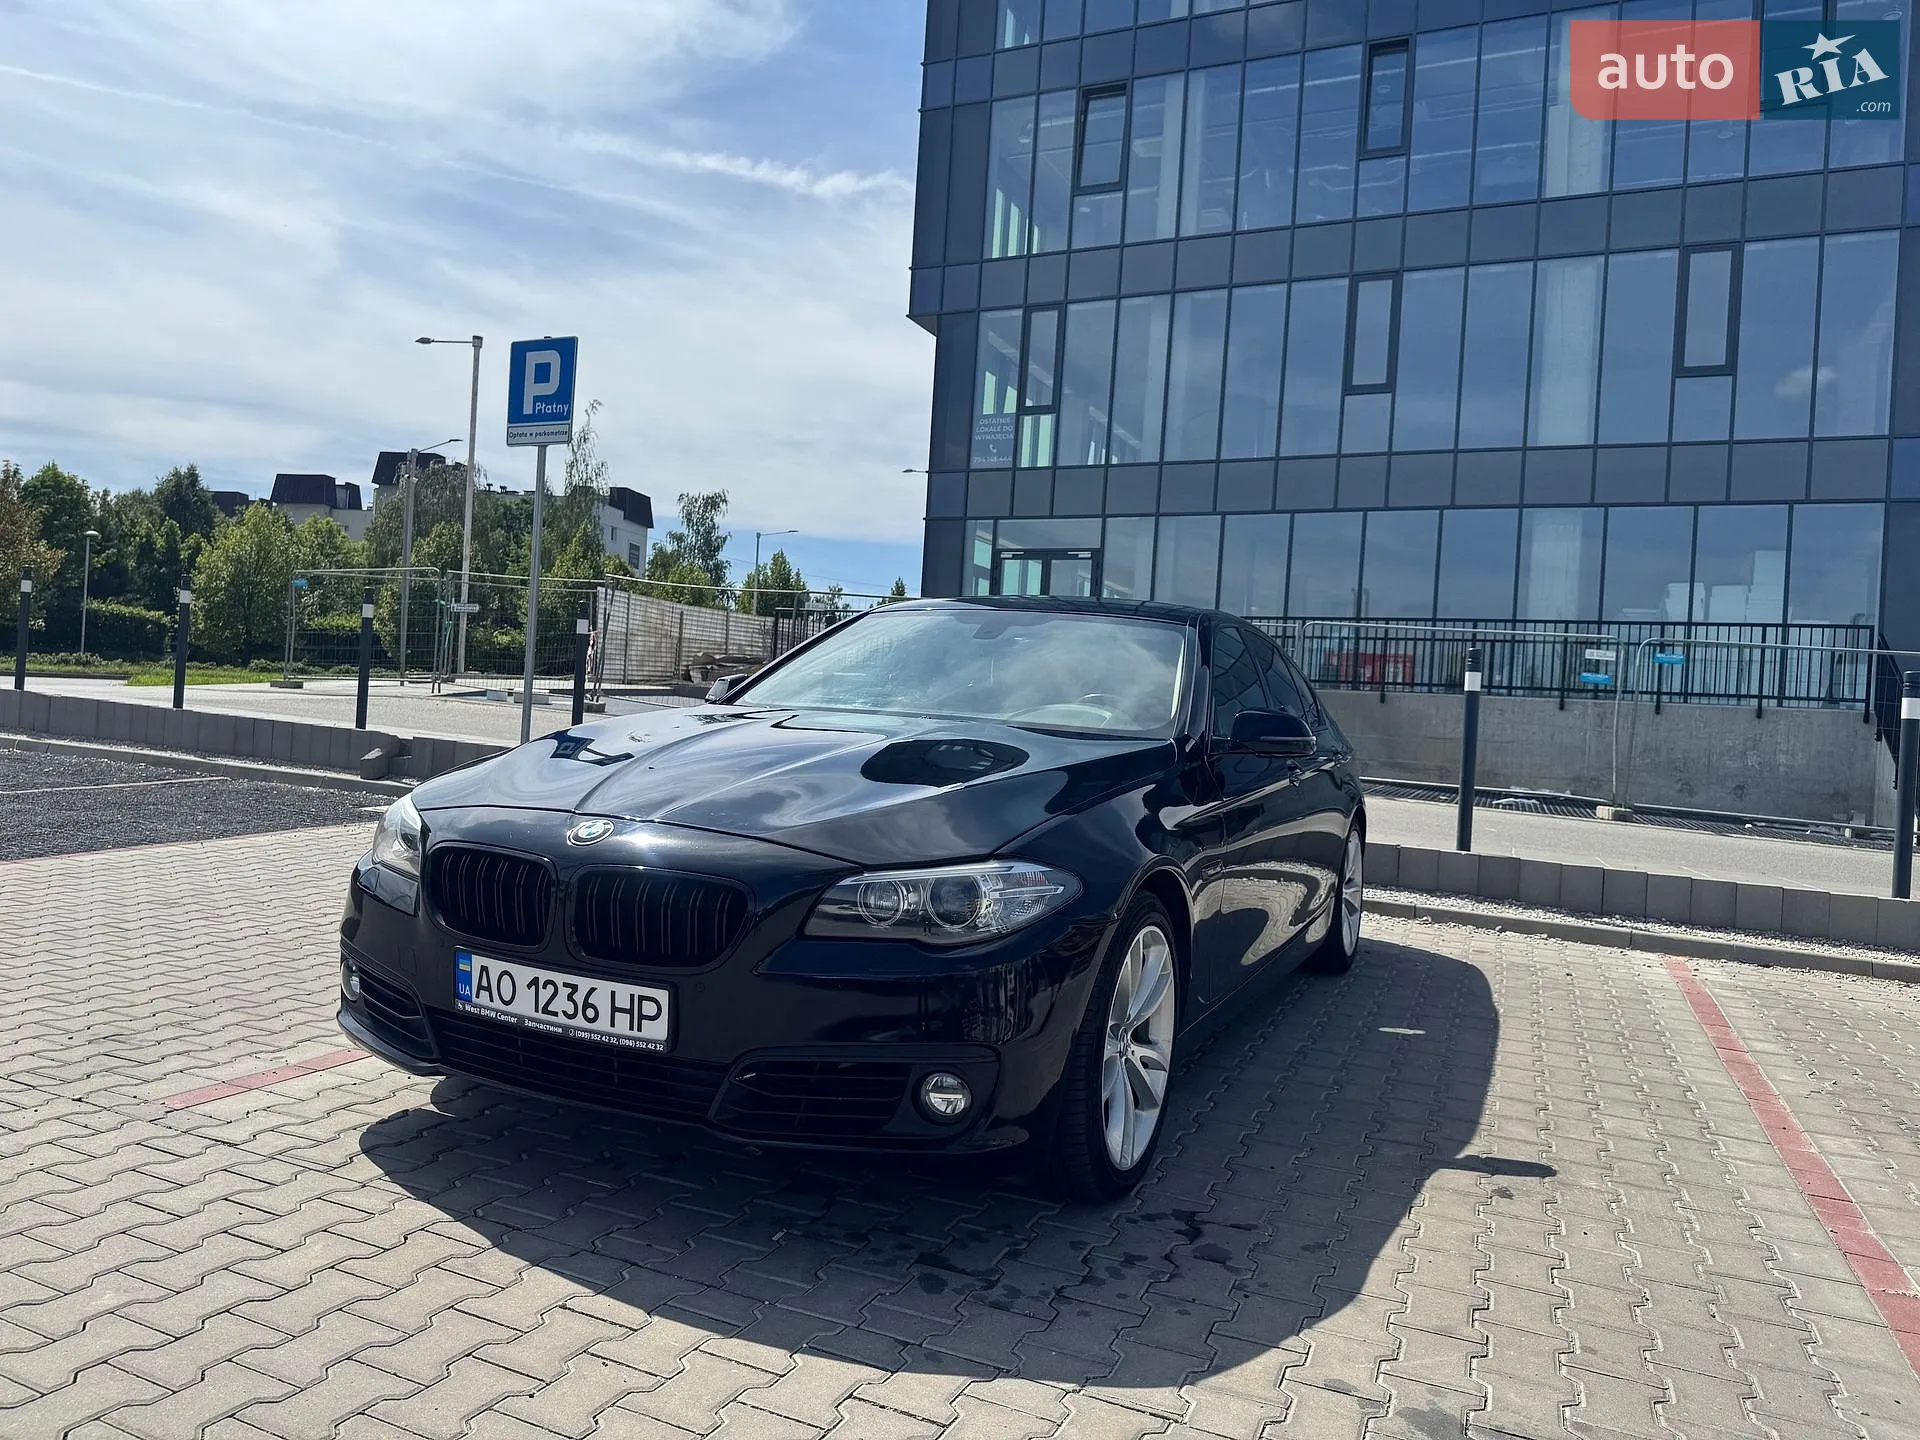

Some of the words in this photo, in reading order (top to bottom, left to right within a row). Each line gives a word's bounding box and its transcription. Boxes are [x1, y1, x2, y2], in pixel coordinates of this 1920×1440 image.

[523, 350, 561, 414] P
[535, 402, 569, 416] Płatny
[508, 431, 528, 439] Opłata
[535, 430, 568, 438] parkometrze
[459, 984, 471, 996] UA
[475, 964, 517, 1007] AO
[526, 976, 600, 1024] 1236
[610, 990, 663, 1032] HP
[465, 1004, 480, 1014] West
[480, 1008, 497, 1018] BMW
[496, 1012, 518, 1023] Center
[524, 1019, 563, 1034] Запчастини
[591, 1033, 601, 1041] 552
[636, 1041, 646, 1049] 552
